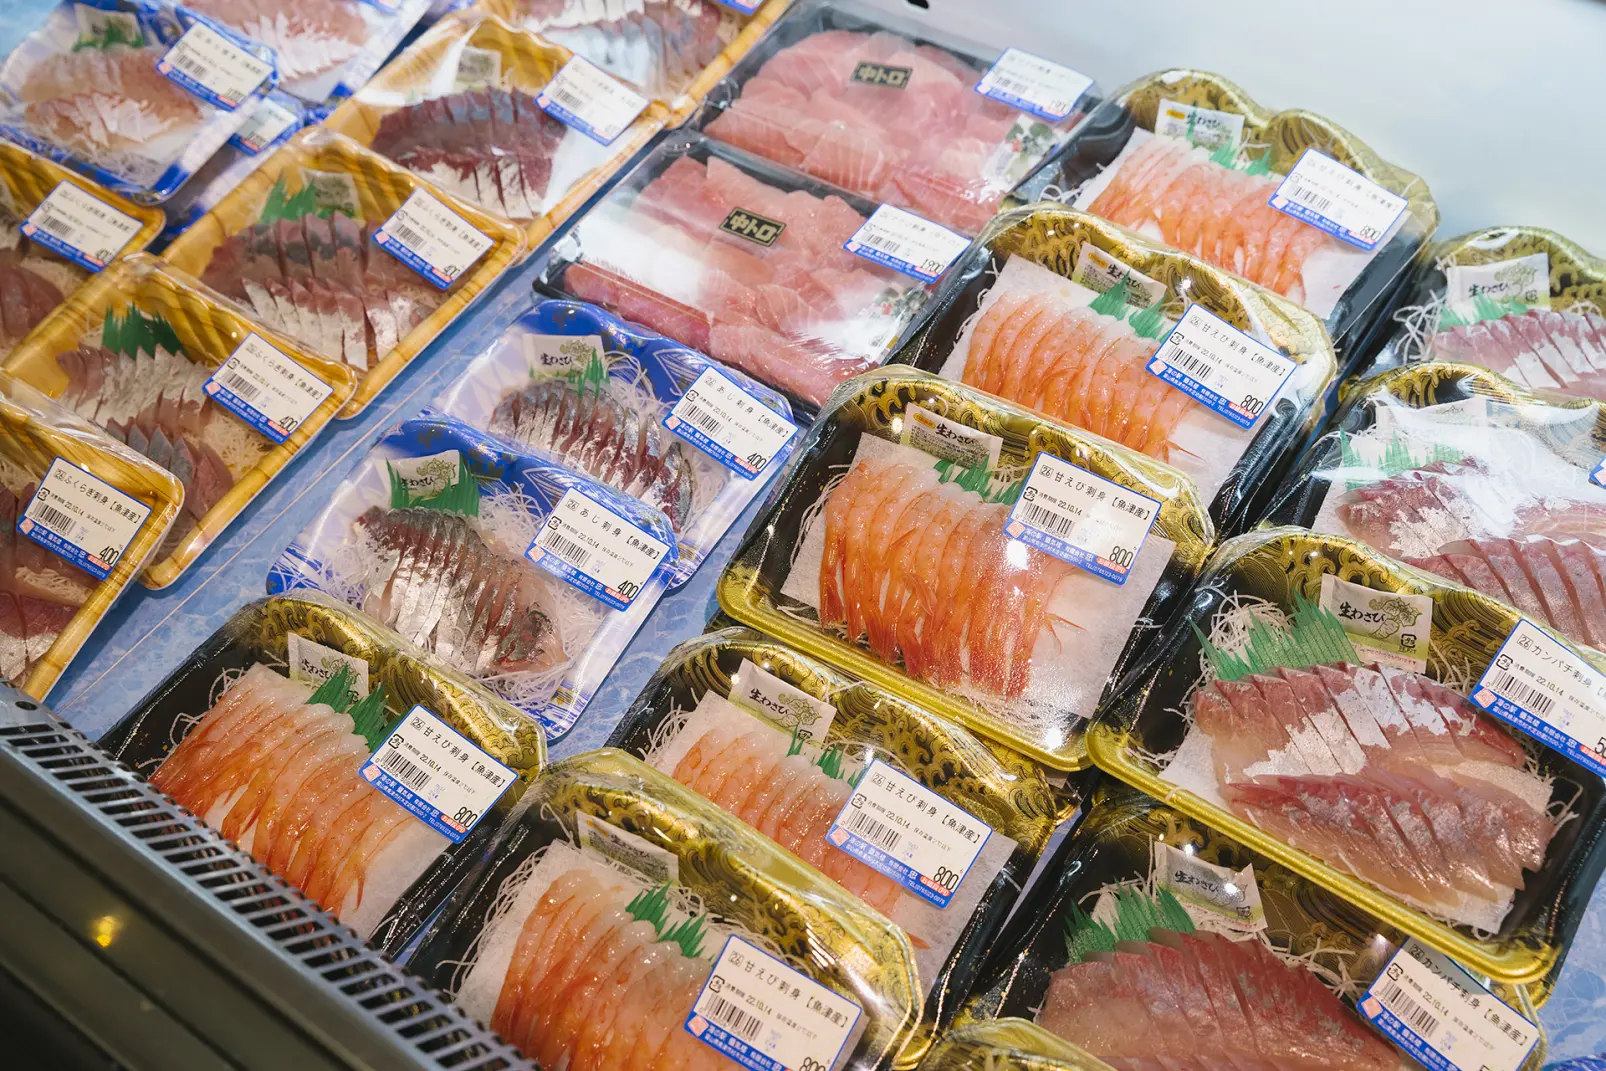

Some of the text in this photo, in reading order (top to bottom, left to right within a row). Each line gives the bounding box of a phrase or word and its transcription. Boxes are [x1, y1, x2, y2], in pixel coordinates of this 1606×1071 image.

[859, 64, 907, 85] 中トロ
[730, 214, 777, 242] 中トロ
[1360, 225, 1381, 241] 800
[1200, 348, 1222, 363] 22.10.14
[1201, 324, 1247, 354] 甘えび刺身
[1251, 352, 1285, 376] 【魚津産】
[716, 385, 754, 413] あじ刺身
[1241, 395, 1263, 414] 800
[278, 414, 297, 431] 400
[935, 423, 975, 444] 生わさび
[746, 452, 766, 469] 400
[63, 474, 109, 505] ふくらぎ刺身
[1041, 466, 1150, 520] 26 甘えび刺身 【魚津産】
[64, 501, 84, 515] 22.10.14
[1057, 500, 1082, 515] 22.10.14
[567, 499, 659, 559] 26 あじ刺身 【魚津産】
[578, 533, 599, 548] 22.10.14
[98, 545, 118, 564] 400
[1109, 545, 1133, 567] 800
[616, 579, 638, 598] 400
[1338, 601, 1385, 623] 生わさび
[1519, 636, 1531, 647] 26
[1536, 676, 1564, 695] 22.10.14
[749, 687, 788, 715] 生わさび
[412, 718, 505, 787] 26 甘えび刺身 【魚津産】
[419, 754, 441, 771] 22.10.14
[454, 807, 476, 827] 800
[873, 774, 980, 843] 26 甘えび刺身 【魚津産】
[886, 811, 910, 828] 22.10.14
[933, 866, 958, 890] 800
[1411, 947, 1422, 958] 26
[730, 953, 848, 1027] 26 甘えび刺身 【魚津産】
[745, 994, 772, 1014] 22.10.14
[1422, 992, 1449, 1015] 22.10.14
